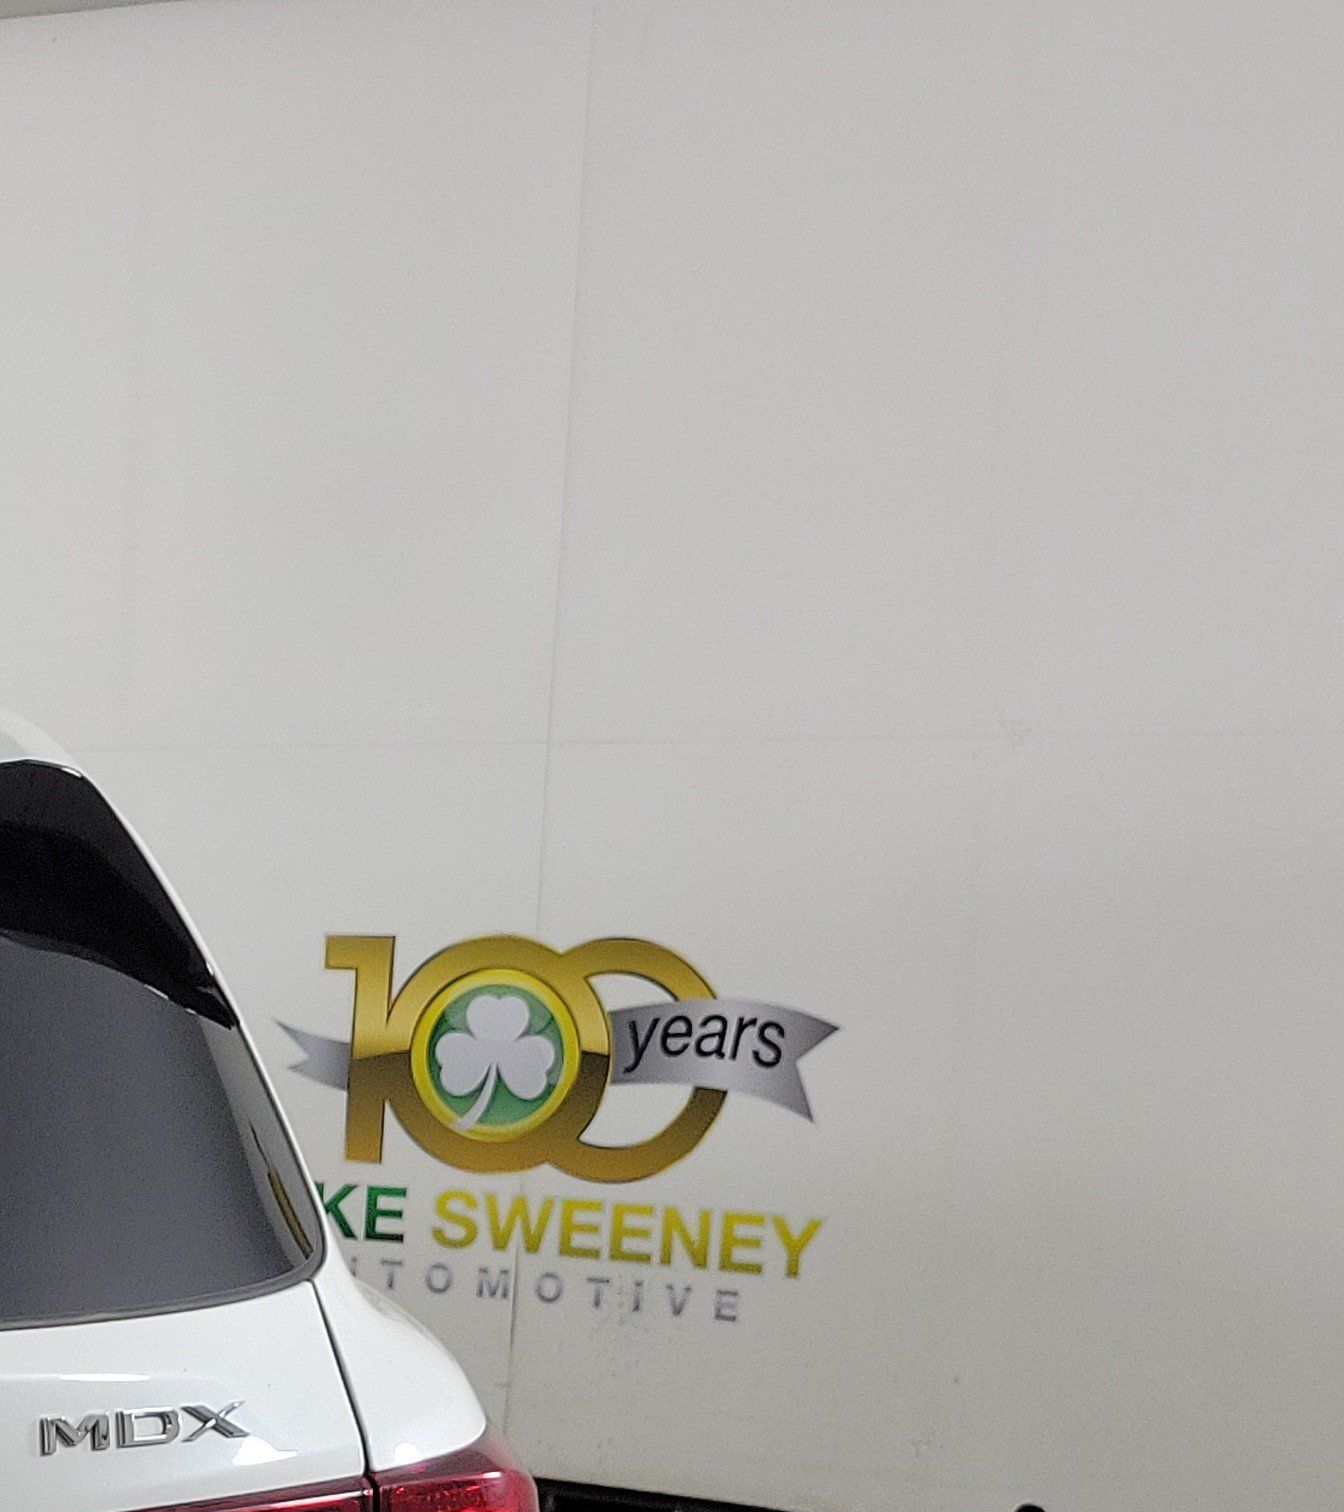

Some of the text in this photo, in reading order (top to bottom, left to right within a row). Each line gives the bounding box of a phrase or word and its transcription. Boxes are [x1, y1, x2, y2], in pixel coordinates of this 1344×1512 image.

[622, 1013, 786, 1074] years
[314, 1181, 822, 1279] KE SWEENEY
[349, 1257, 741, 1323] TOMOTIVE
[38, 1399, 250, 1457] MDX
